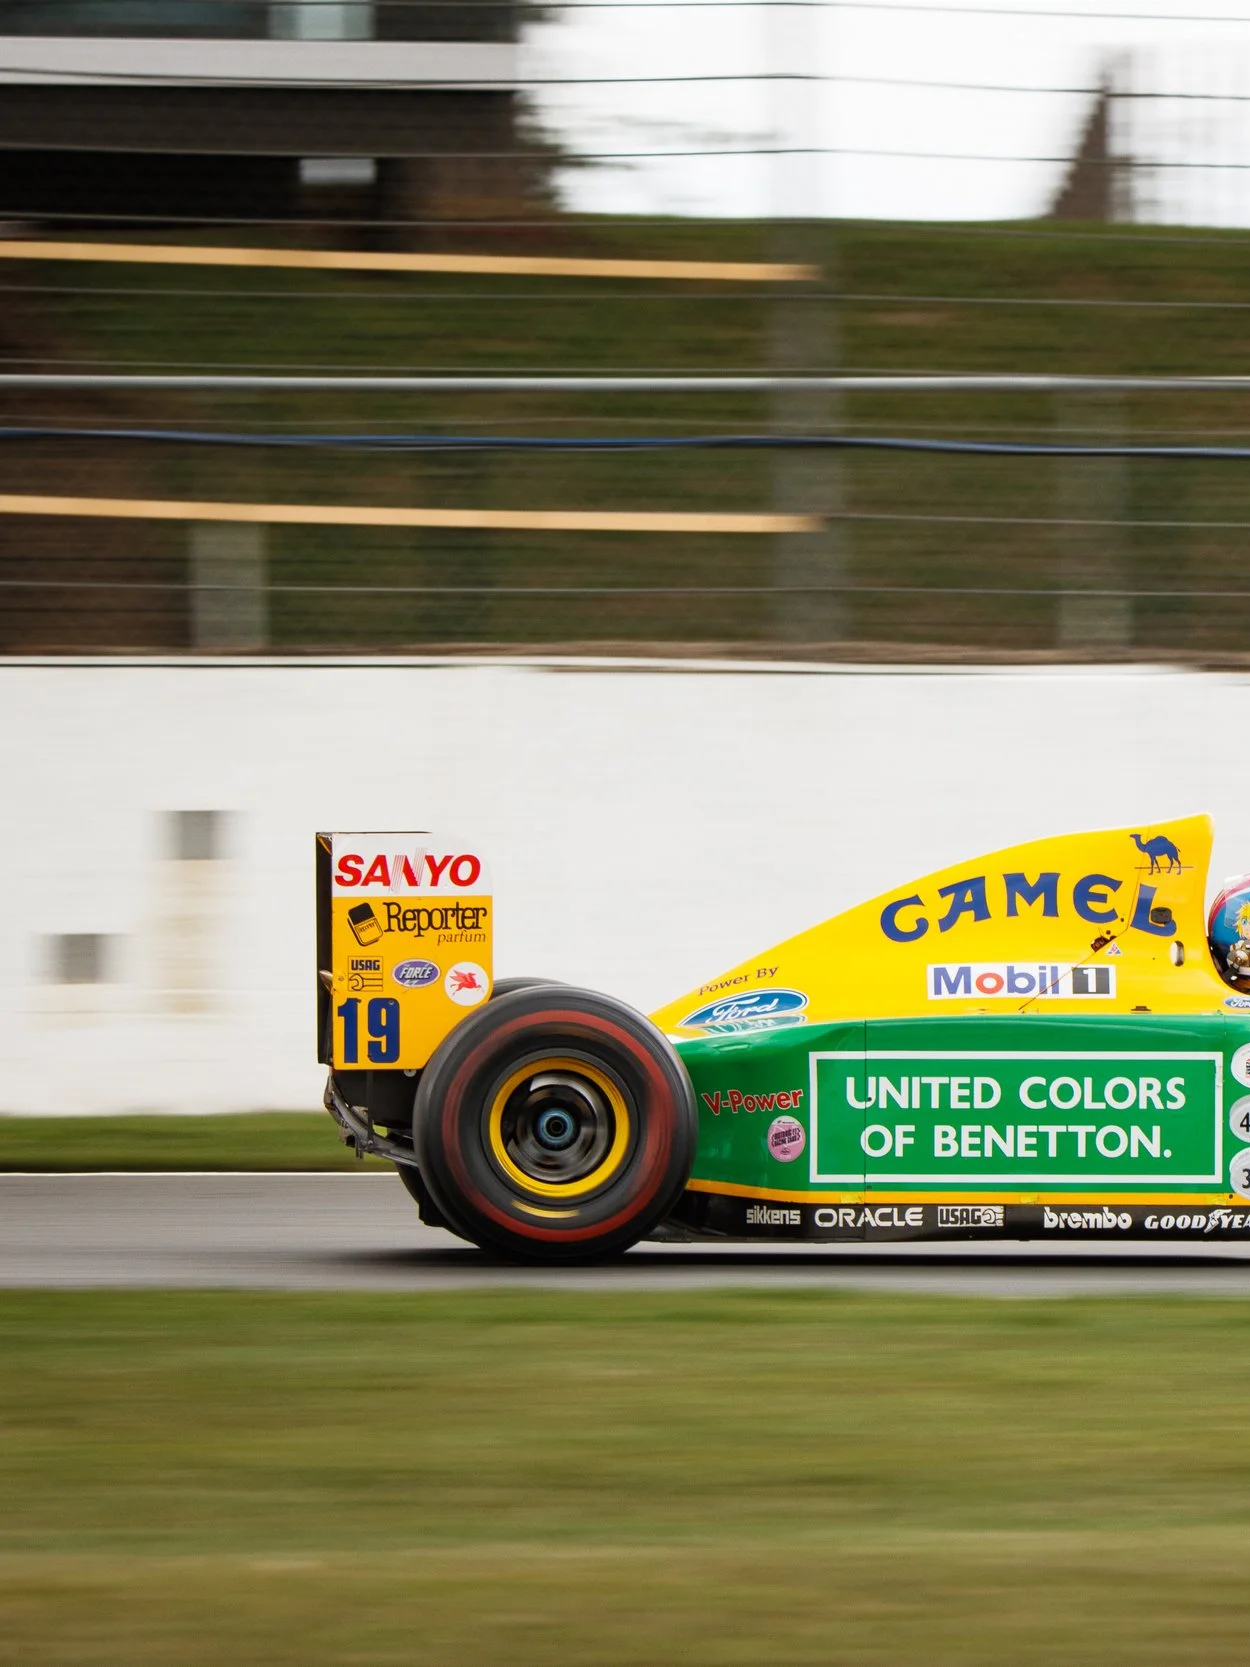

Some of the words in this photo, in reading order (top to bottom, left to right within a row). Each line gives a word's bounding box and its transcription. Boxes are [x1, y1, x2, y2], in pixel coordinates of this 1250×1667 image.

[335, 850, 481, 890] SANYO
[383, 902, 487, 937] Reporter
[880, 872, 1177, 943] CAMEL
[437, 930, 487, 946] parfum
[351, 959, 380, 971] USAG
[400, 966, 433, 979] FORCE
[698, 974, 751, 996] Power
[756, 966, 779, 979] By
[933, 965, 1059, 995] Mobil
[705, 996, 779, 1023] Ford
[337, 997, 400, 1064] 19
[701, 1088, 803, 1115] V-Power
[846, 1076, 1001, 1109] UNITED
[1019, 1076, 1185, 1109] COLORS
[860, 1124, 914, 1158] OF
[934, 1124, 1172, 1158] BENETTON.
[746, 1205, 801, 1225] sikkens
[814, 1207, 923, 1228] ORACLE
[939, 1208, 981, 1225] USAG
[1044, 1206, 1132, 1229] brembo
